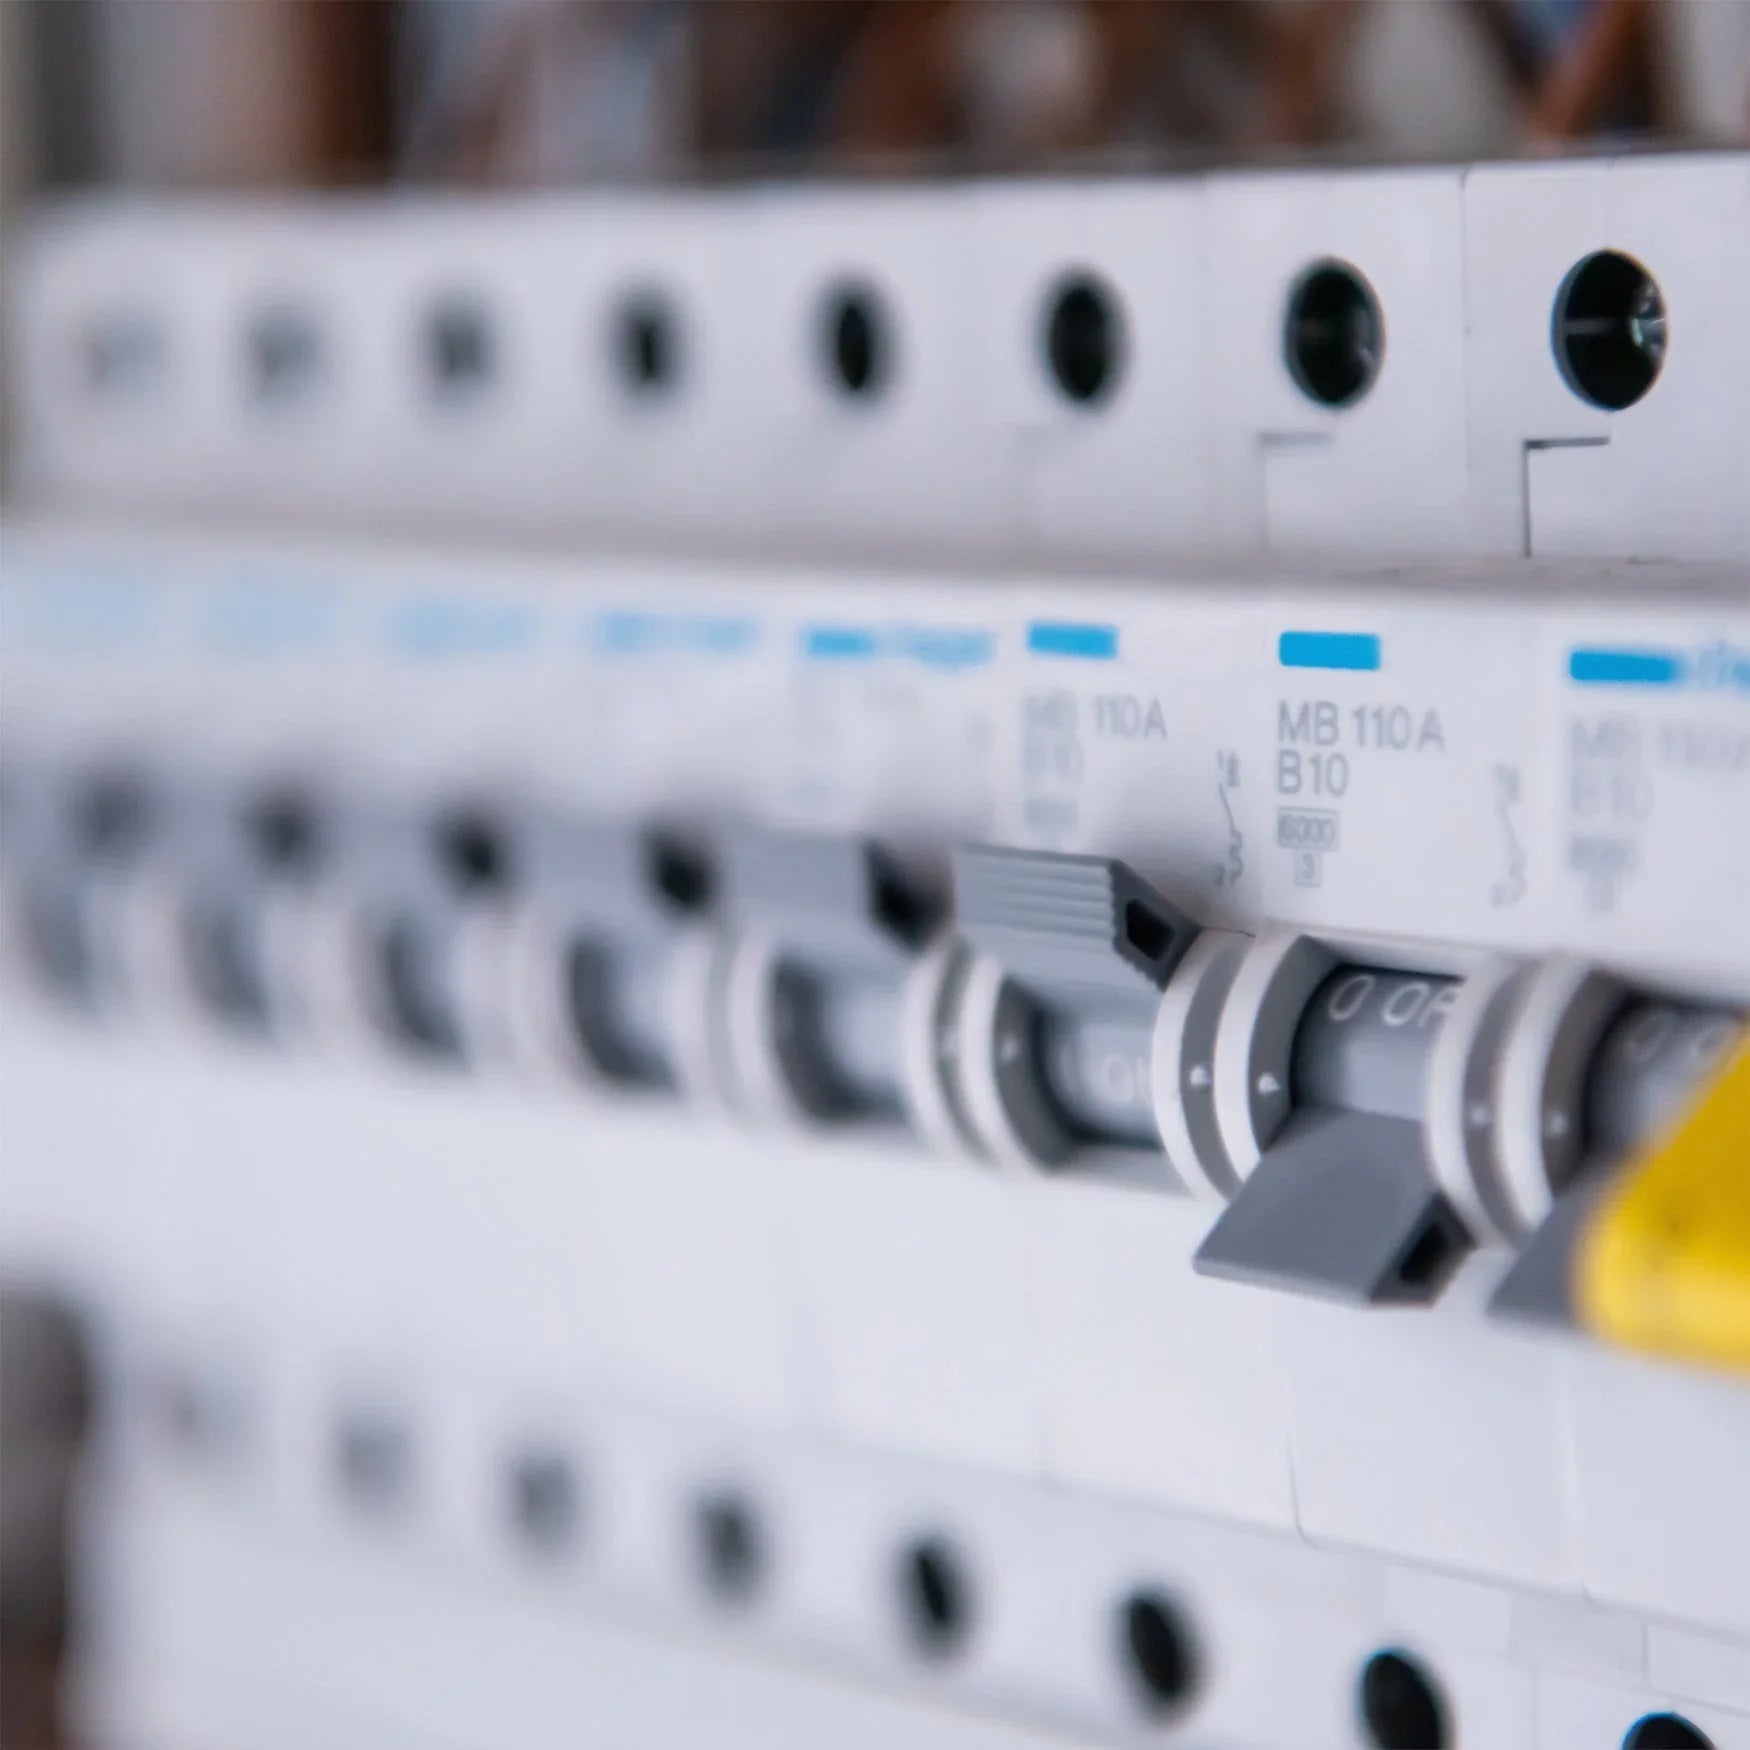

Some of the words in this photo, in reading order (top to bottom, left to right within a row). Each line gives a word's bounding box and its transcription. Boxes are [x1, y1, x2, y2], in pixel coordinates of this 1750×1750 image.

[1091, 693, 1168, 740] 110A
[1278, 700, 1339, 746] MB
[1353, 703, 1446, 752] 110A
[1278, 749, 1349, 798] B10
[1328, 974, 1378, 1021] 0
